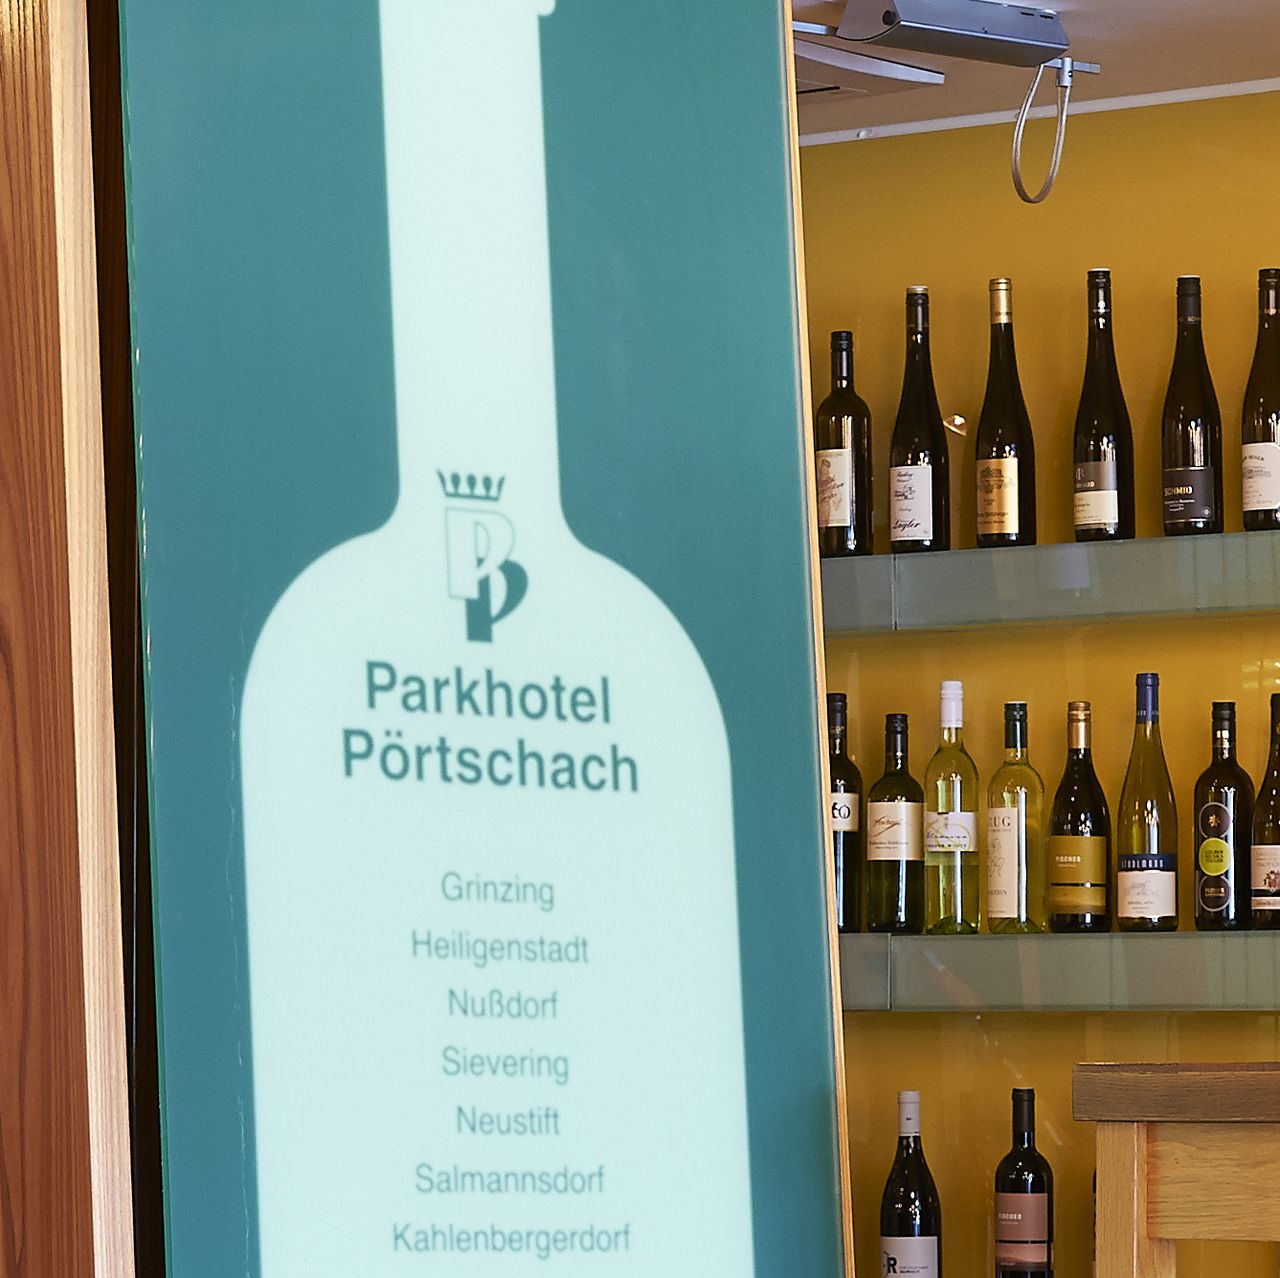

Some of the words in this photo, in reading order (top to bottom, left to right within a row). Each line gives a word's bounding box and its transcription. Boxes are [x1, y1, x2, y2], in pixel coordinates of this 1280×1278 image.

[365, 660, 612, 724] Parkhotel
[342, 728, 640, 793] Pörtschach
[441, 872, 555, 912] Grinzing
[411, 930, 589, 968] Heiligenstadt
[448, 988, 558, 1019] Nußdorf
[442, 1046, 570, 1085] Sievering
[456, 1105, 560, 1136] Neustift
[415, 1163, 605, 1194] Salmannsdorf
[393, 1223, 631, 1260] Kahlenbergerdorf
